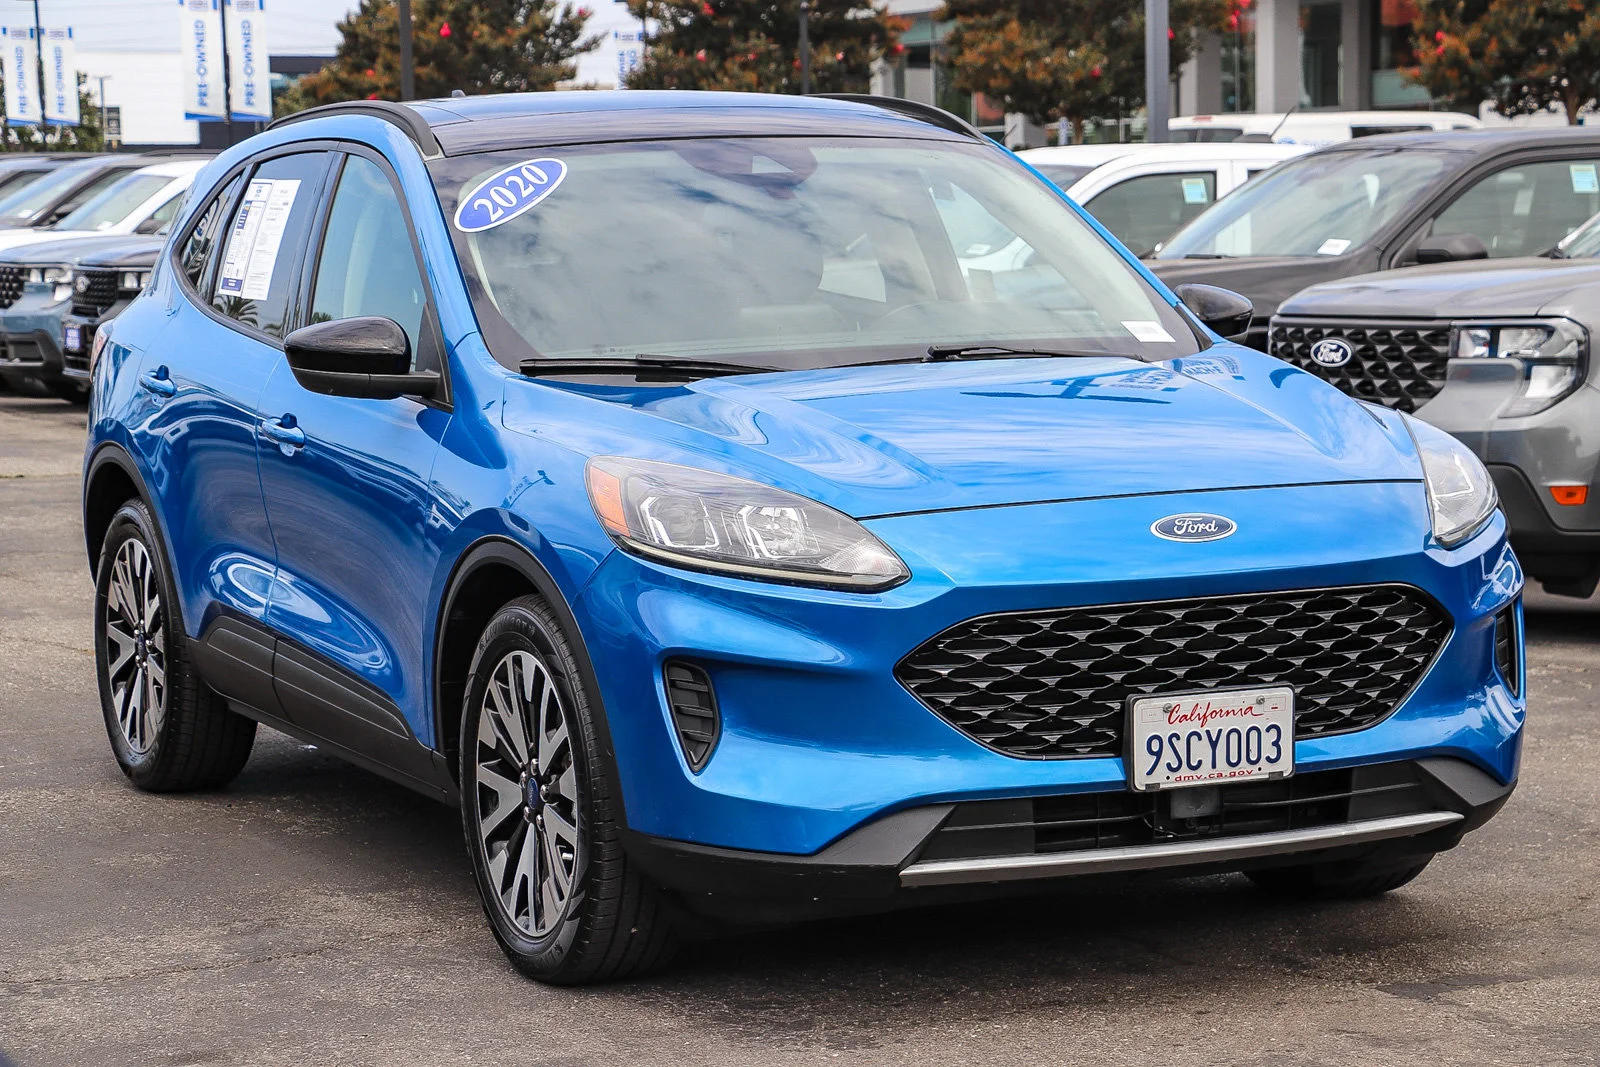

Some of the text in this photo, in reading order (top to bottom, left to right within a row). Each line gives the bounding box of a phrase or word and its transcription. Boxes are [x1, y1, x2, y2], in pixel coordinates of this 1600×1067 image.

[194, 19, 208, 107] PRE-OWNED
[241, 19, 254, 107] PRE-OWNED
[473, 164, 549, 223] 2020
[1317, 342, 1344, 363] Ford
[1173, 517, 1219, 535] Ford
[1167, 701, 1264, 728] California
[1145, 723, 1282, 776] 9SCY003
[1174, 768, 1254, 782] dmv.ca.gov
